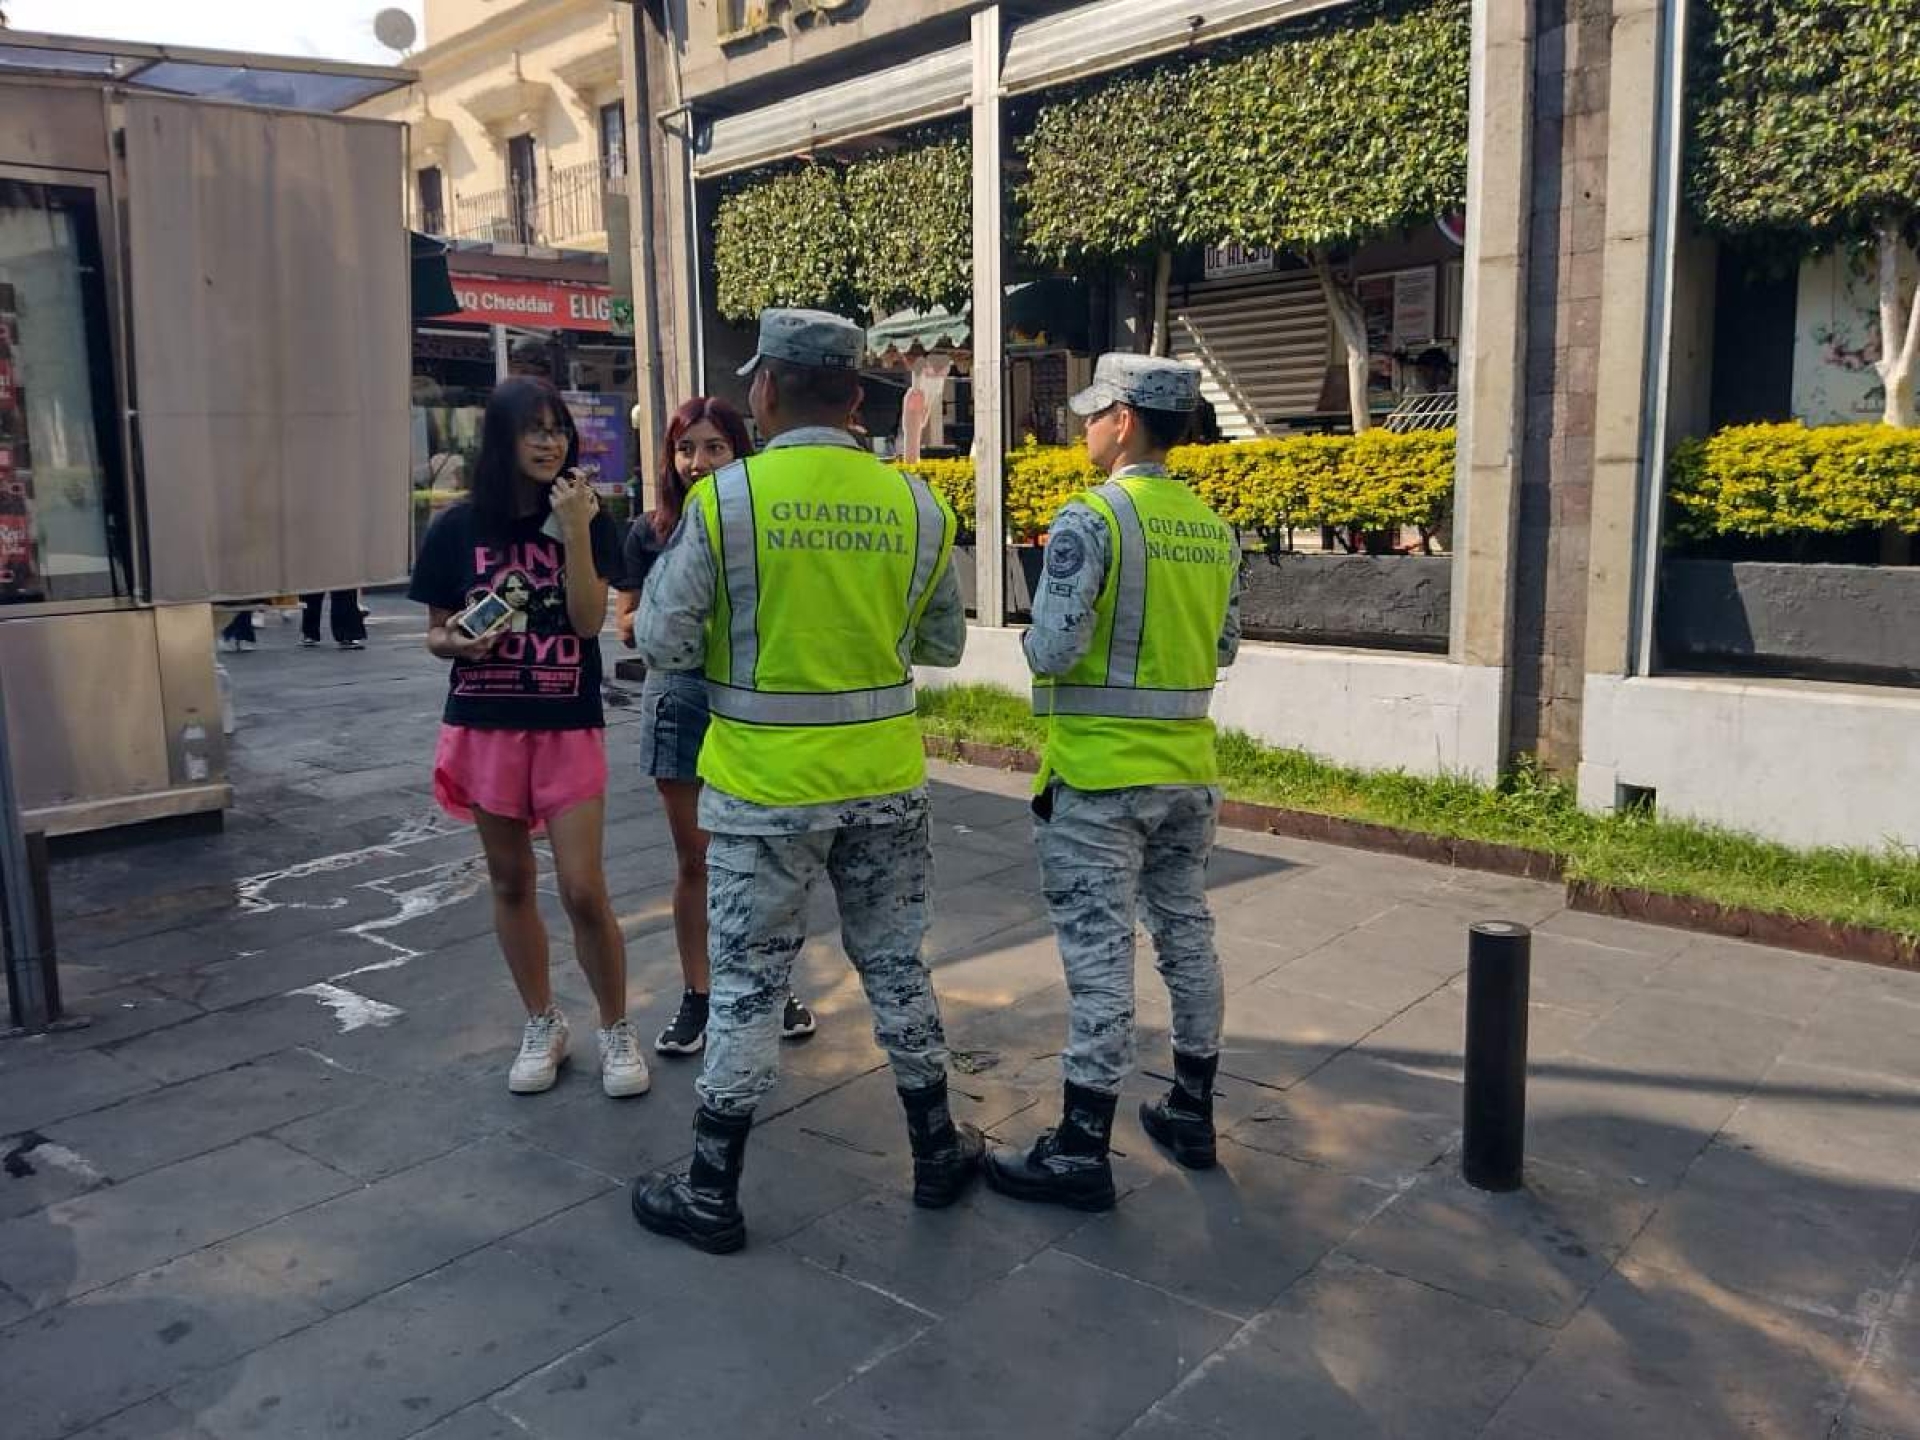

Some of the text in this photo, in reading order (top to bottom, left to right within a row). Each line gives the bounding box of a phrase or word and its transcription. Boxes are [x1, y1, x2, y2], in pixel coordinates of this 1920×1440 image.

[481, 292, 554, 314] Cheddar
[771, 501, 902, 526] GUARDIA
[766, 528, 909, 555] NACIONAL
[1148, 517, 1229, 543] GUARDIA
[474, 542, 560, 575] PIN
[498, 633, 582, 665] OYD
